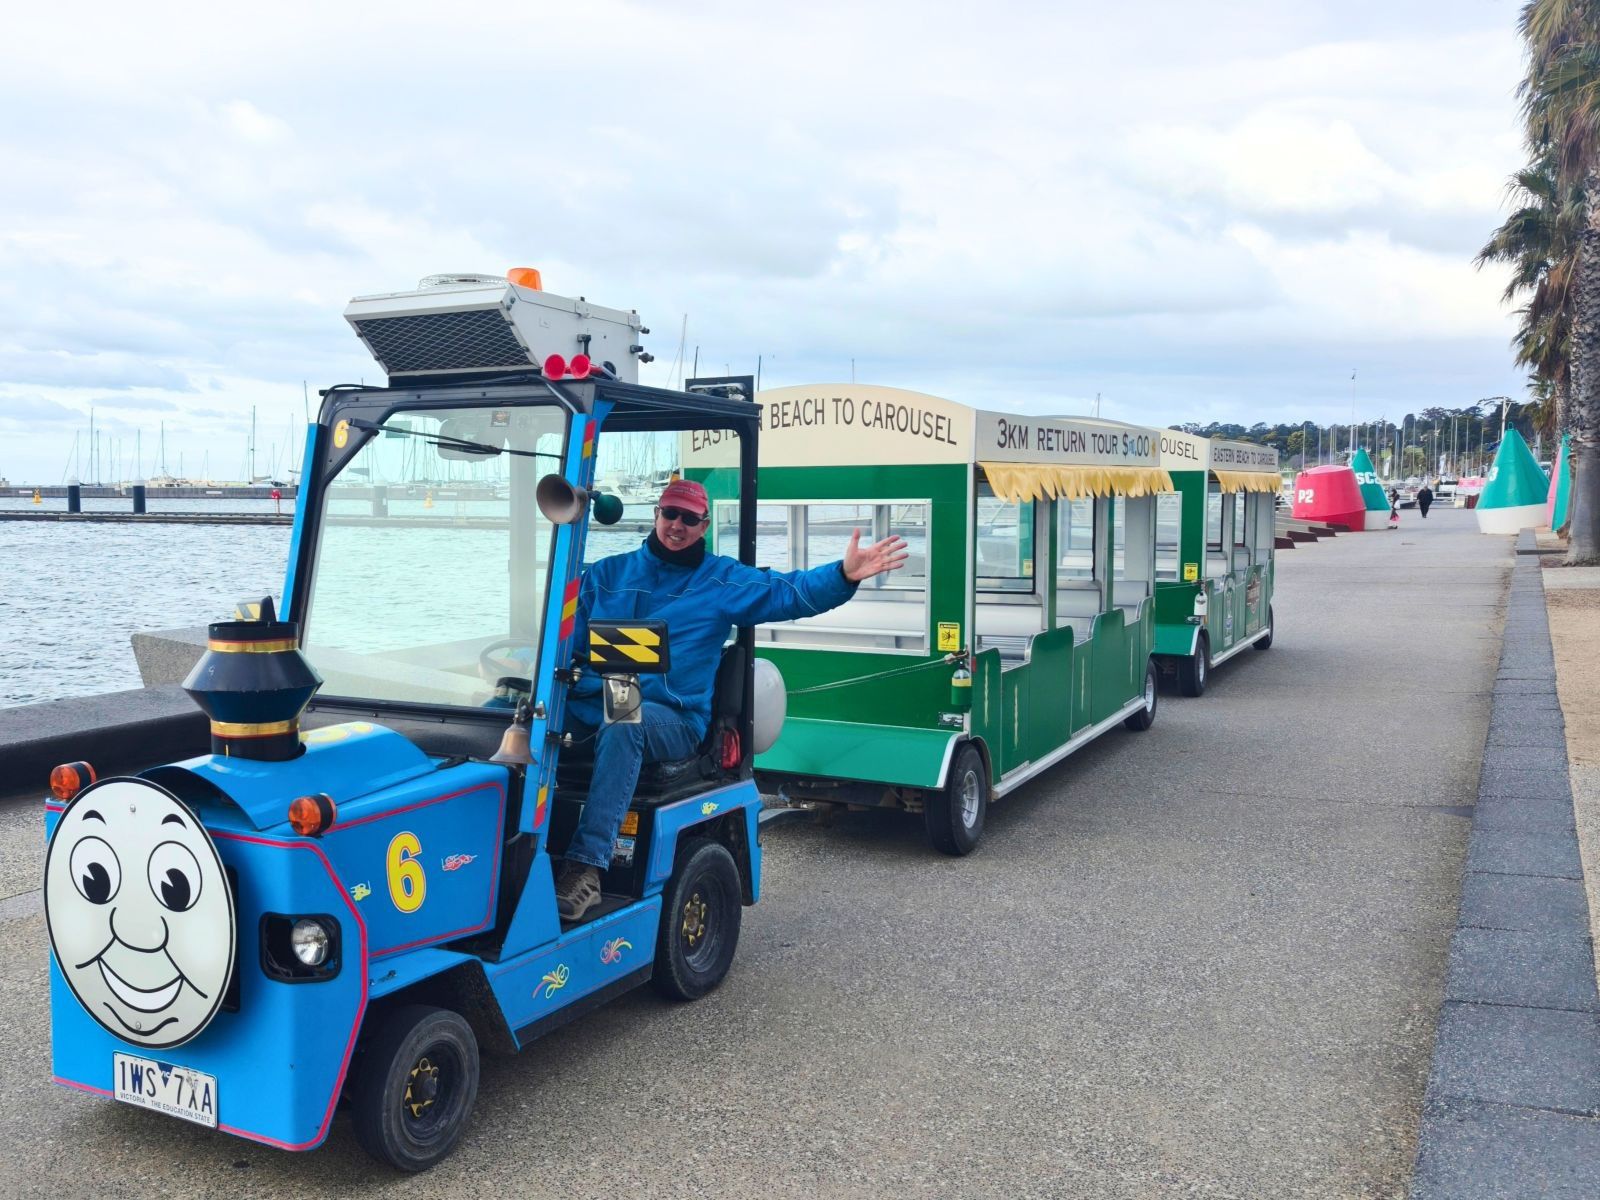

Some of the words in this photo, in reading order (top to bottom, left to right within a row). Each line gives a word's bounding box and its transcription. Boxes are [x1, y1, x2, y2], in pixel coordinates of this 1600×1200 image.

[333, 420, 350, 449] 6
[770, 398, 826, 430] BEACH
[832, 398, 856, 425] TO
[861, 400, 958, 446] CAROUSEL
[997, 417, 1029, 450] 3KM
[1037, 427, 1087, 453] RETURN
[1091, 432, 1119, 455] TOUR
[1160, 438, 1198, 460] OUSEL
[1214, 447, 1235, 463] EASTERN
[1236, 450, 1250, 464] BEACH
[1251, 451, 1257, 464] TO
[1297, 488, 1315, 504] P2
[386, 830, 427, 914] 6
[120, 1061, 156, 1097] 1WS
[120, 1091, 146, 1104] VICTORIA
[151, 1100, 162, 1109] THE
[162, 1103, 194, 1117] EDUCATION
[194, 1113, 211, 1124] STATE
